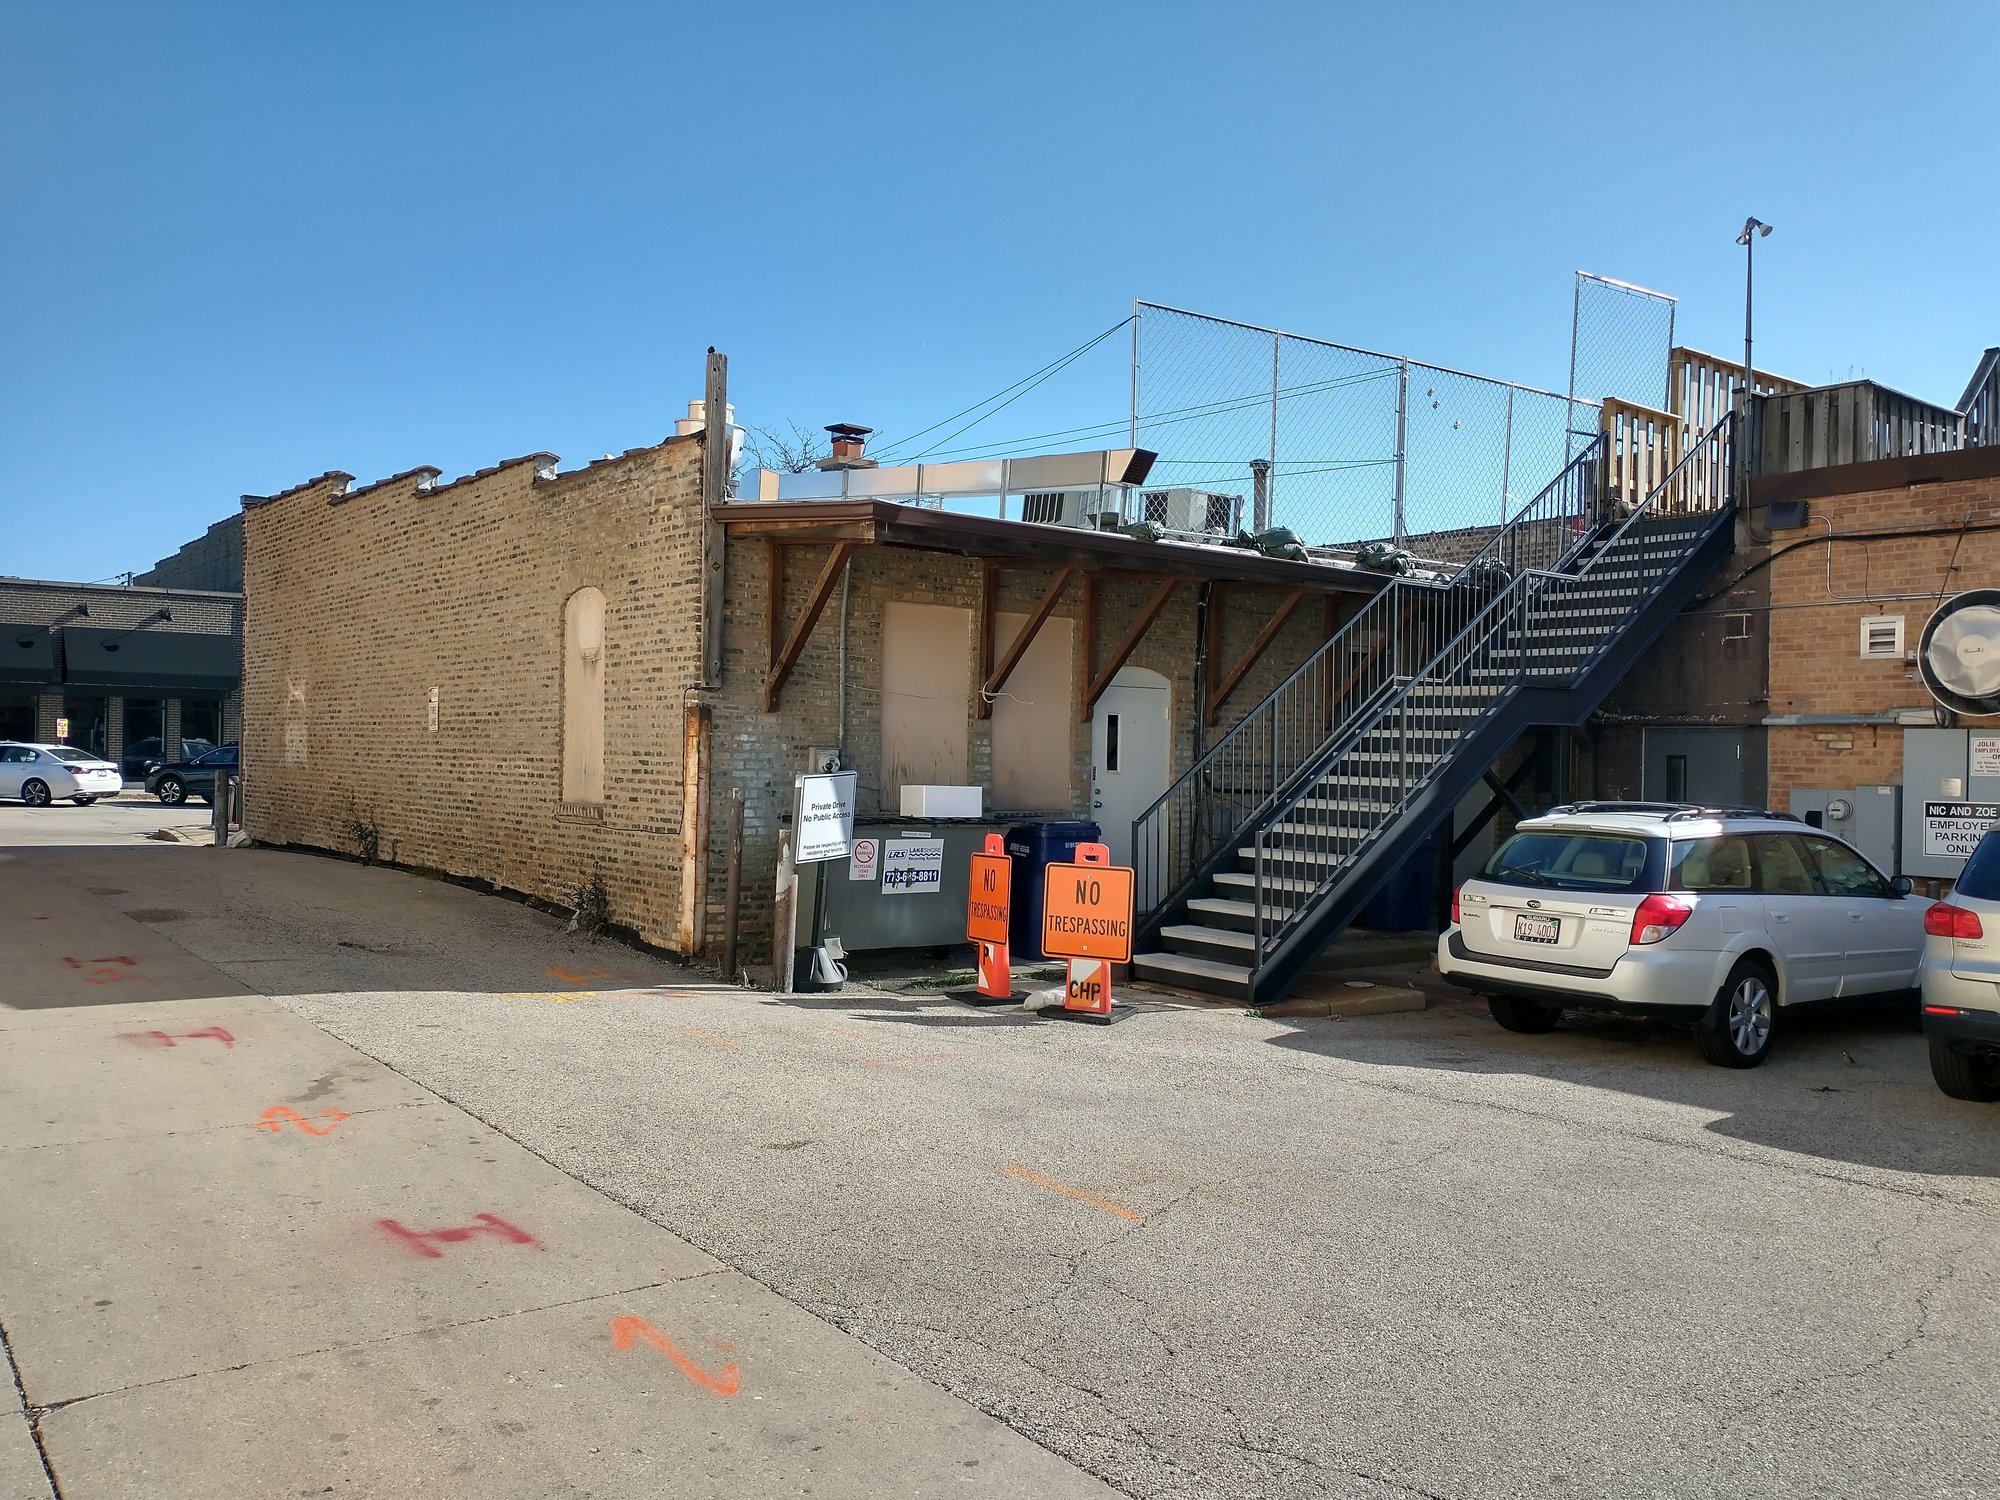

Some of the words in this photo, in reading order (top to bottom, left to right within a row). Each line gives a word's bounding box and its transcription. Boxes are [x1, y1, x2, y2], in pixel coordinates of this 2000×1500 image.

[811, 802, 832, 811] Private
[832, 801, 846, 809] Drive
[1929, 805, 1946, 815] NIC
[1949, 806, 1972, 816] AND
[1975, 807, 1997, 817] ZOE
[803, 815, 812, 823] No
[813, 812, 831, 821] Public
[832, 811, 851, 819] Access
[1935, 832, 1983, 842] PARKIN
[983, 868, 995, 892] NO
[1075, 879, 1101, 906] NO
[970, 901, 1007, 923] TRESPASSING
[1048, 914, 1126, 937] TRESPASSING
[1517, 921, 1532, 935] K19
[1536, 924, 1556, 938] 4003
[1070, 980, 1101, 1001] CHP
